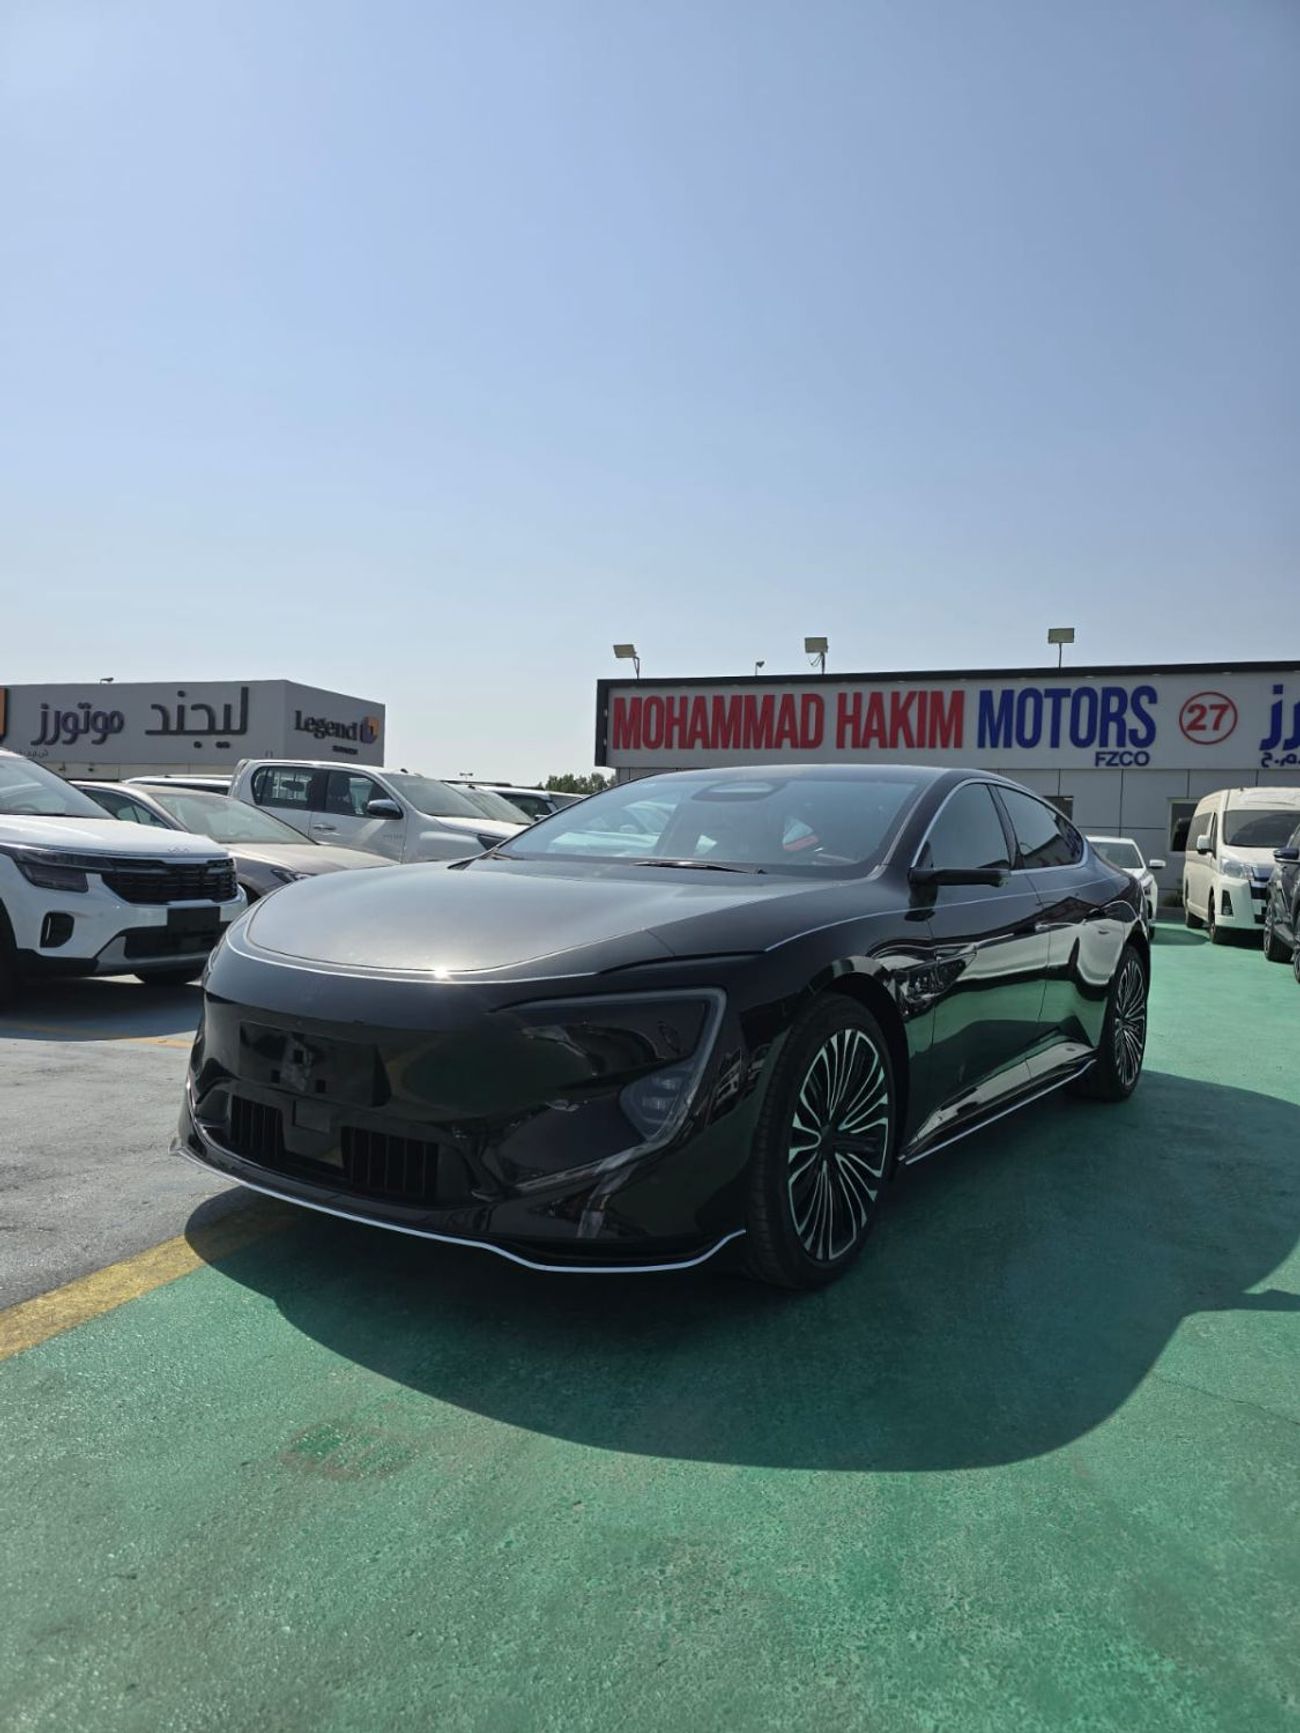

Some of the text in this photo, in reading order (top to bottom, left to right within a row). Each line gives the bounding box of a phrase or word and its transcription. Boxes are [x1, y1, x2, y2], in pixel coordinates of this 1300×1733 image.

[30, 686, 249, 749] ليجند موتورز
[294, 710, 358, 741] Legend
[613, 685, 1158, 751] MOHAMMAD HAKIM MOTORS
[1186, 704, 1230, 731] 27
[1095, 751, 1150, 768] FZCO
